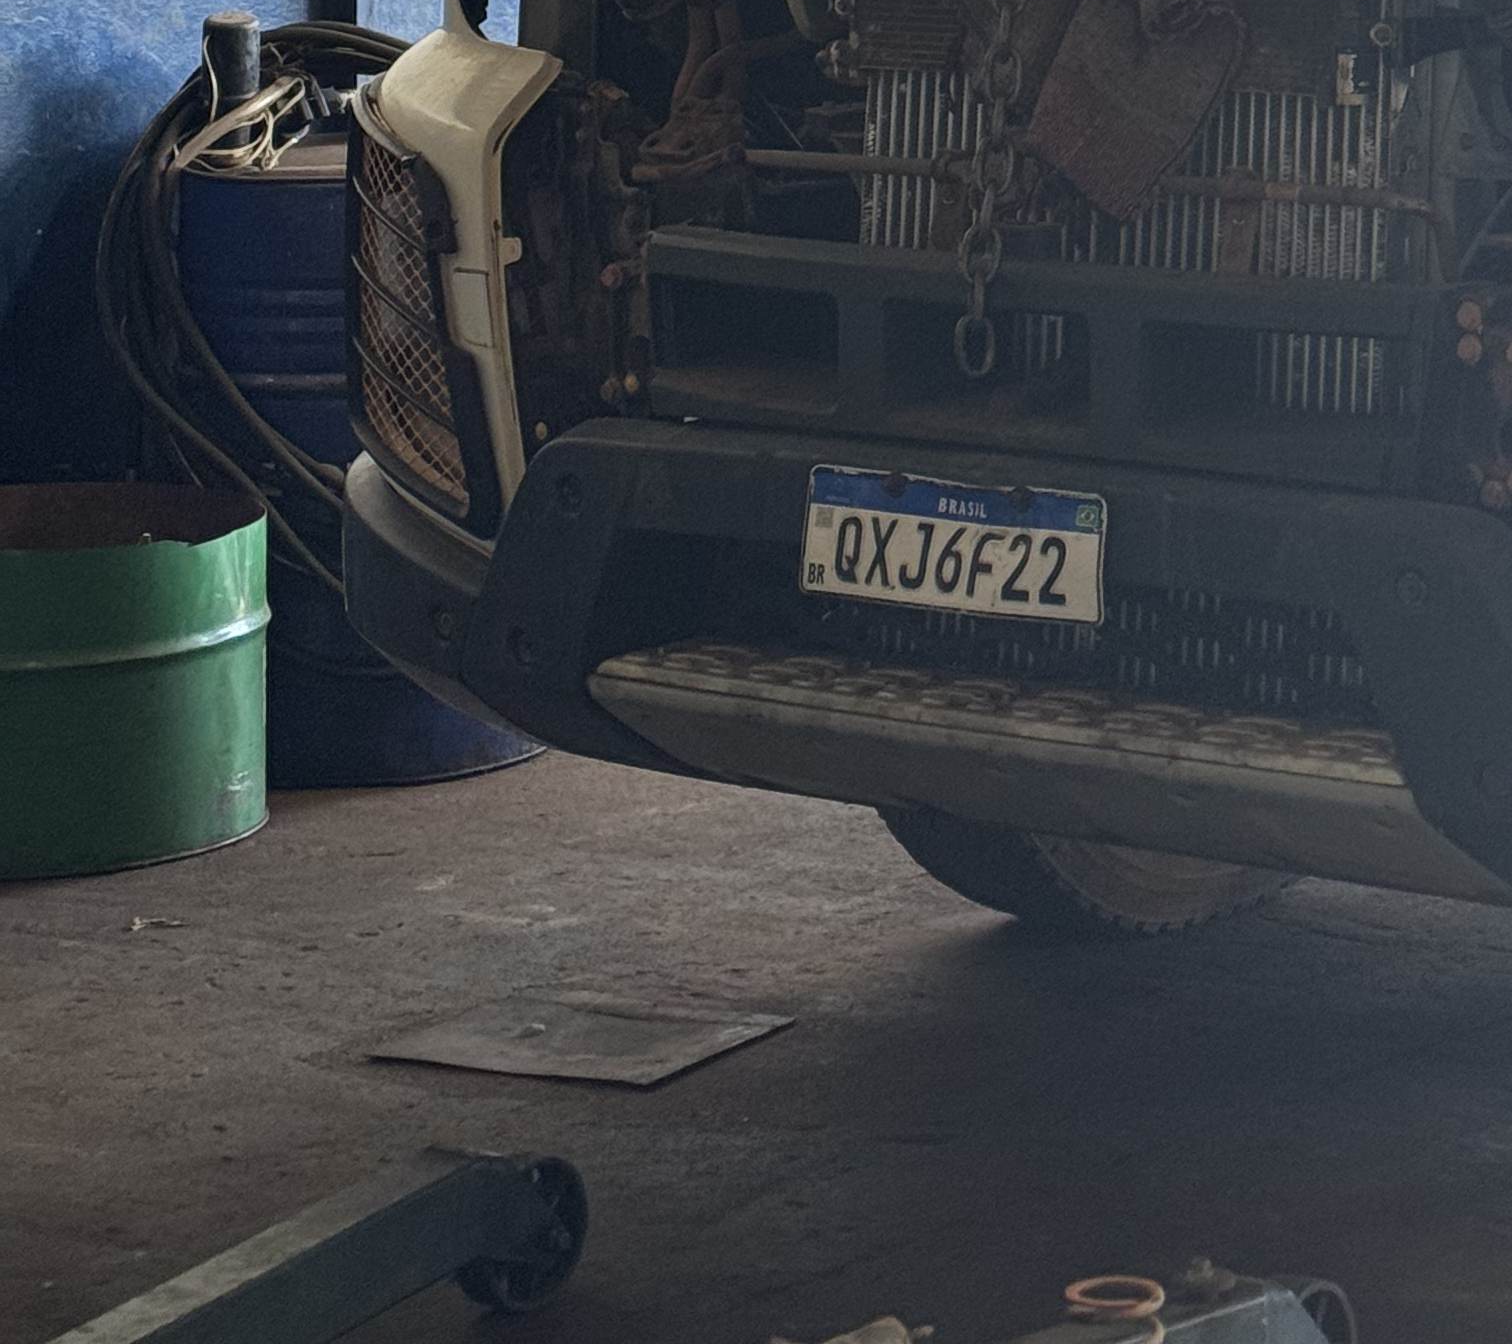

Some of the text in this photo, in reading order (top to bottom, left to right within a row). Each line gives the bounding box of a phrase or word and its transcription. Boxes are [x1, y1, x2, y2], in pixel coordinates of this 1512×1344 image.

[938, 497, 987, 519] BRASIL
[834, 515, 1067, 606] QXJ6F22
[807, 563, 825, 586] BR
